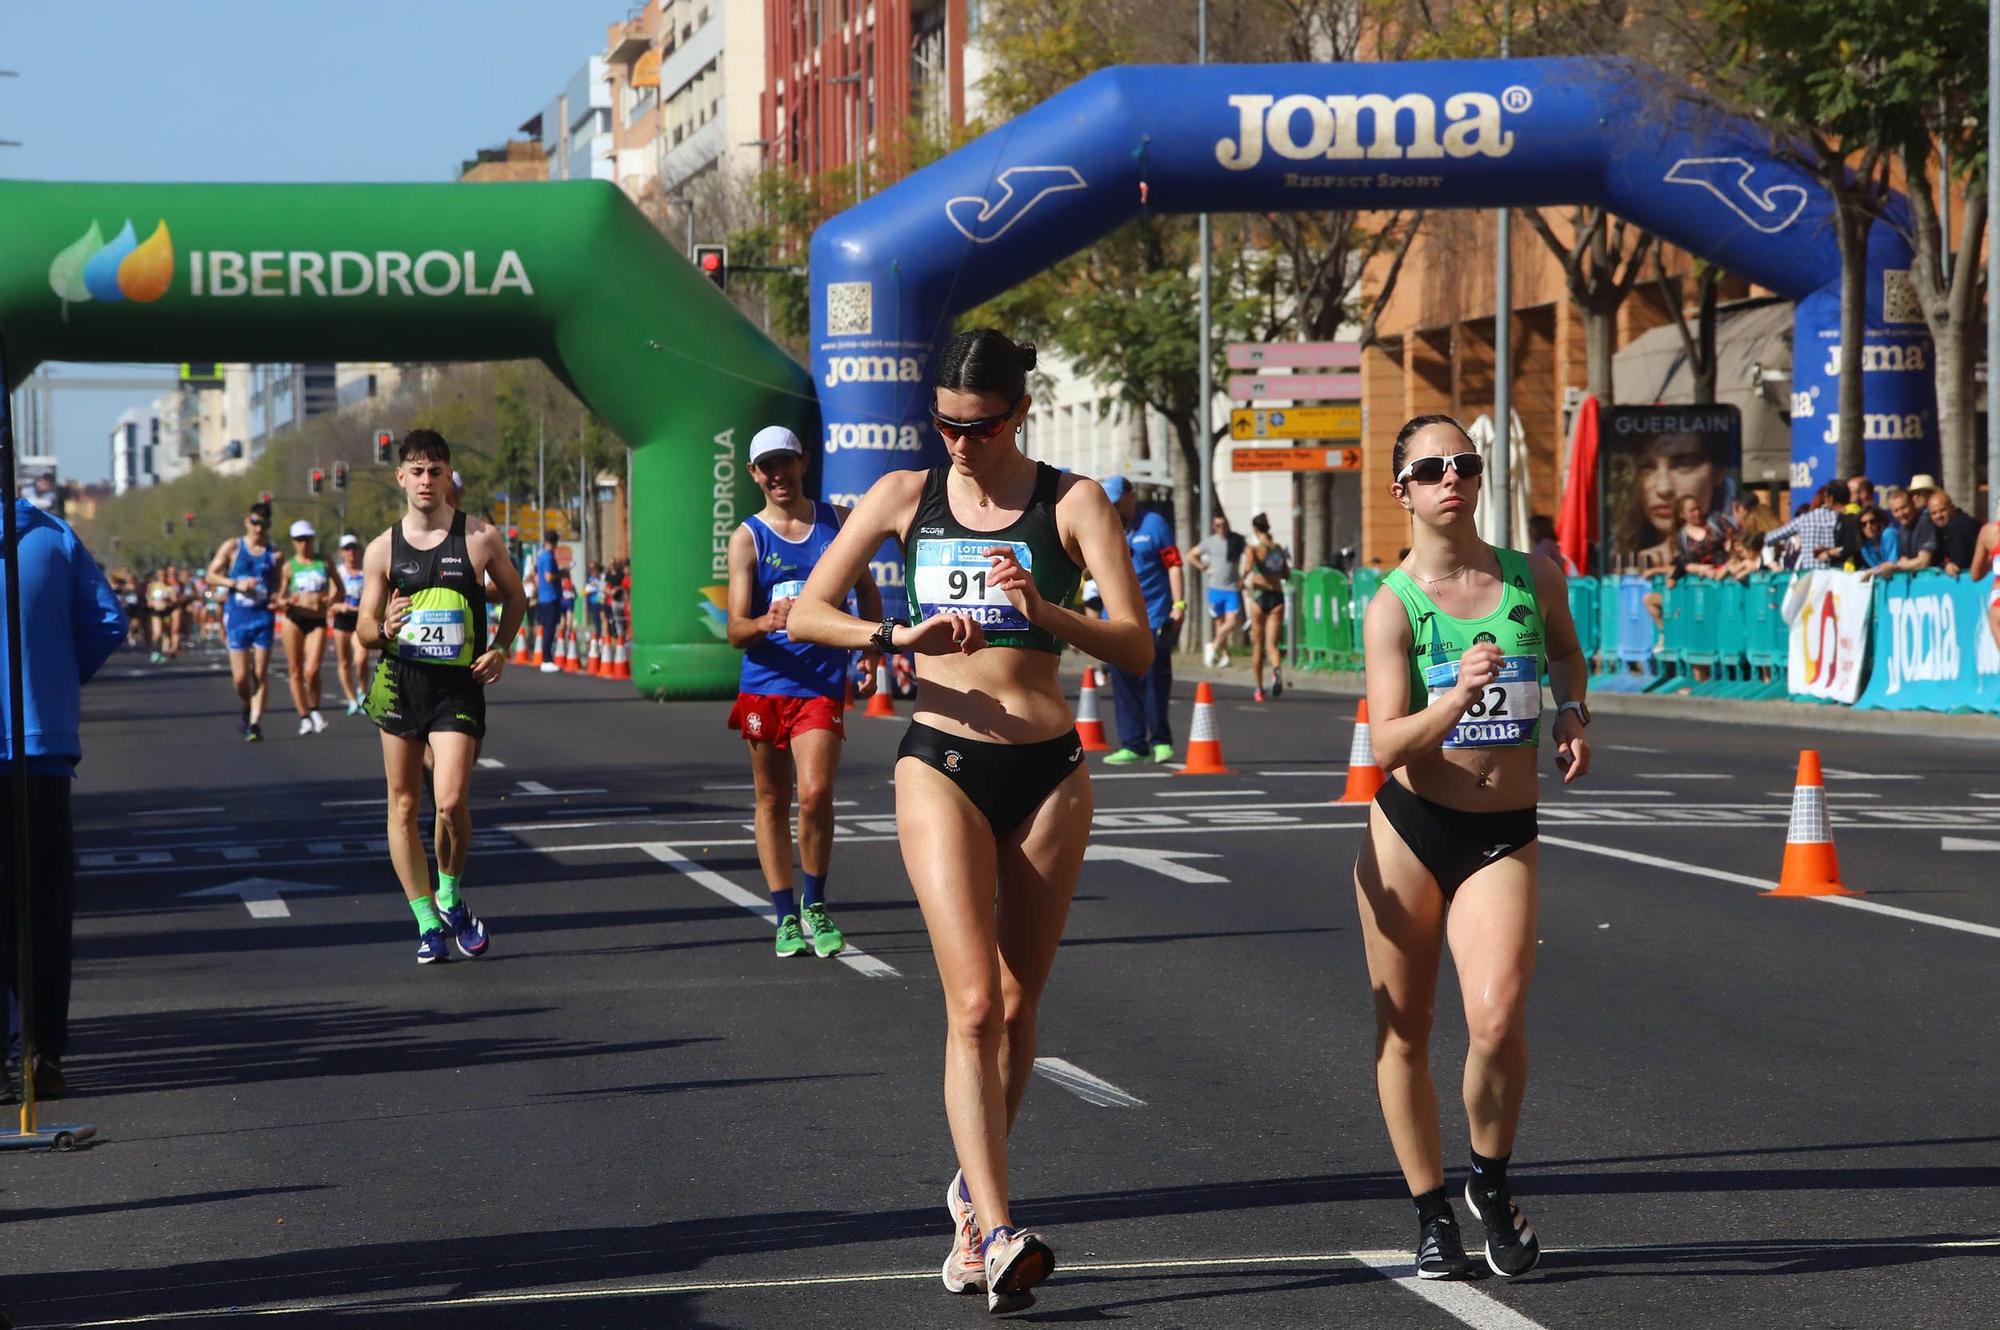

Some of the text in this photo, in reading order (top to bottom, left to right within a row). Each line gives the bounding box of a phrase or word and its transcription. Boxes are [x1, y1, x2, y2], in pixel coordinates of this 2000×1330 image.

[189, 250, 535, 297] IBERDROLA
[1615, 416, 1729, 433] GUERLAIN
[1823, 413, 1925, 444] Jma
[712, 428, 735, 580] IBERDROLA
[948, 570, 986, 600] 91
[420, 627, 444, 642] 24
[1466, 686, 1508, 718] 82
